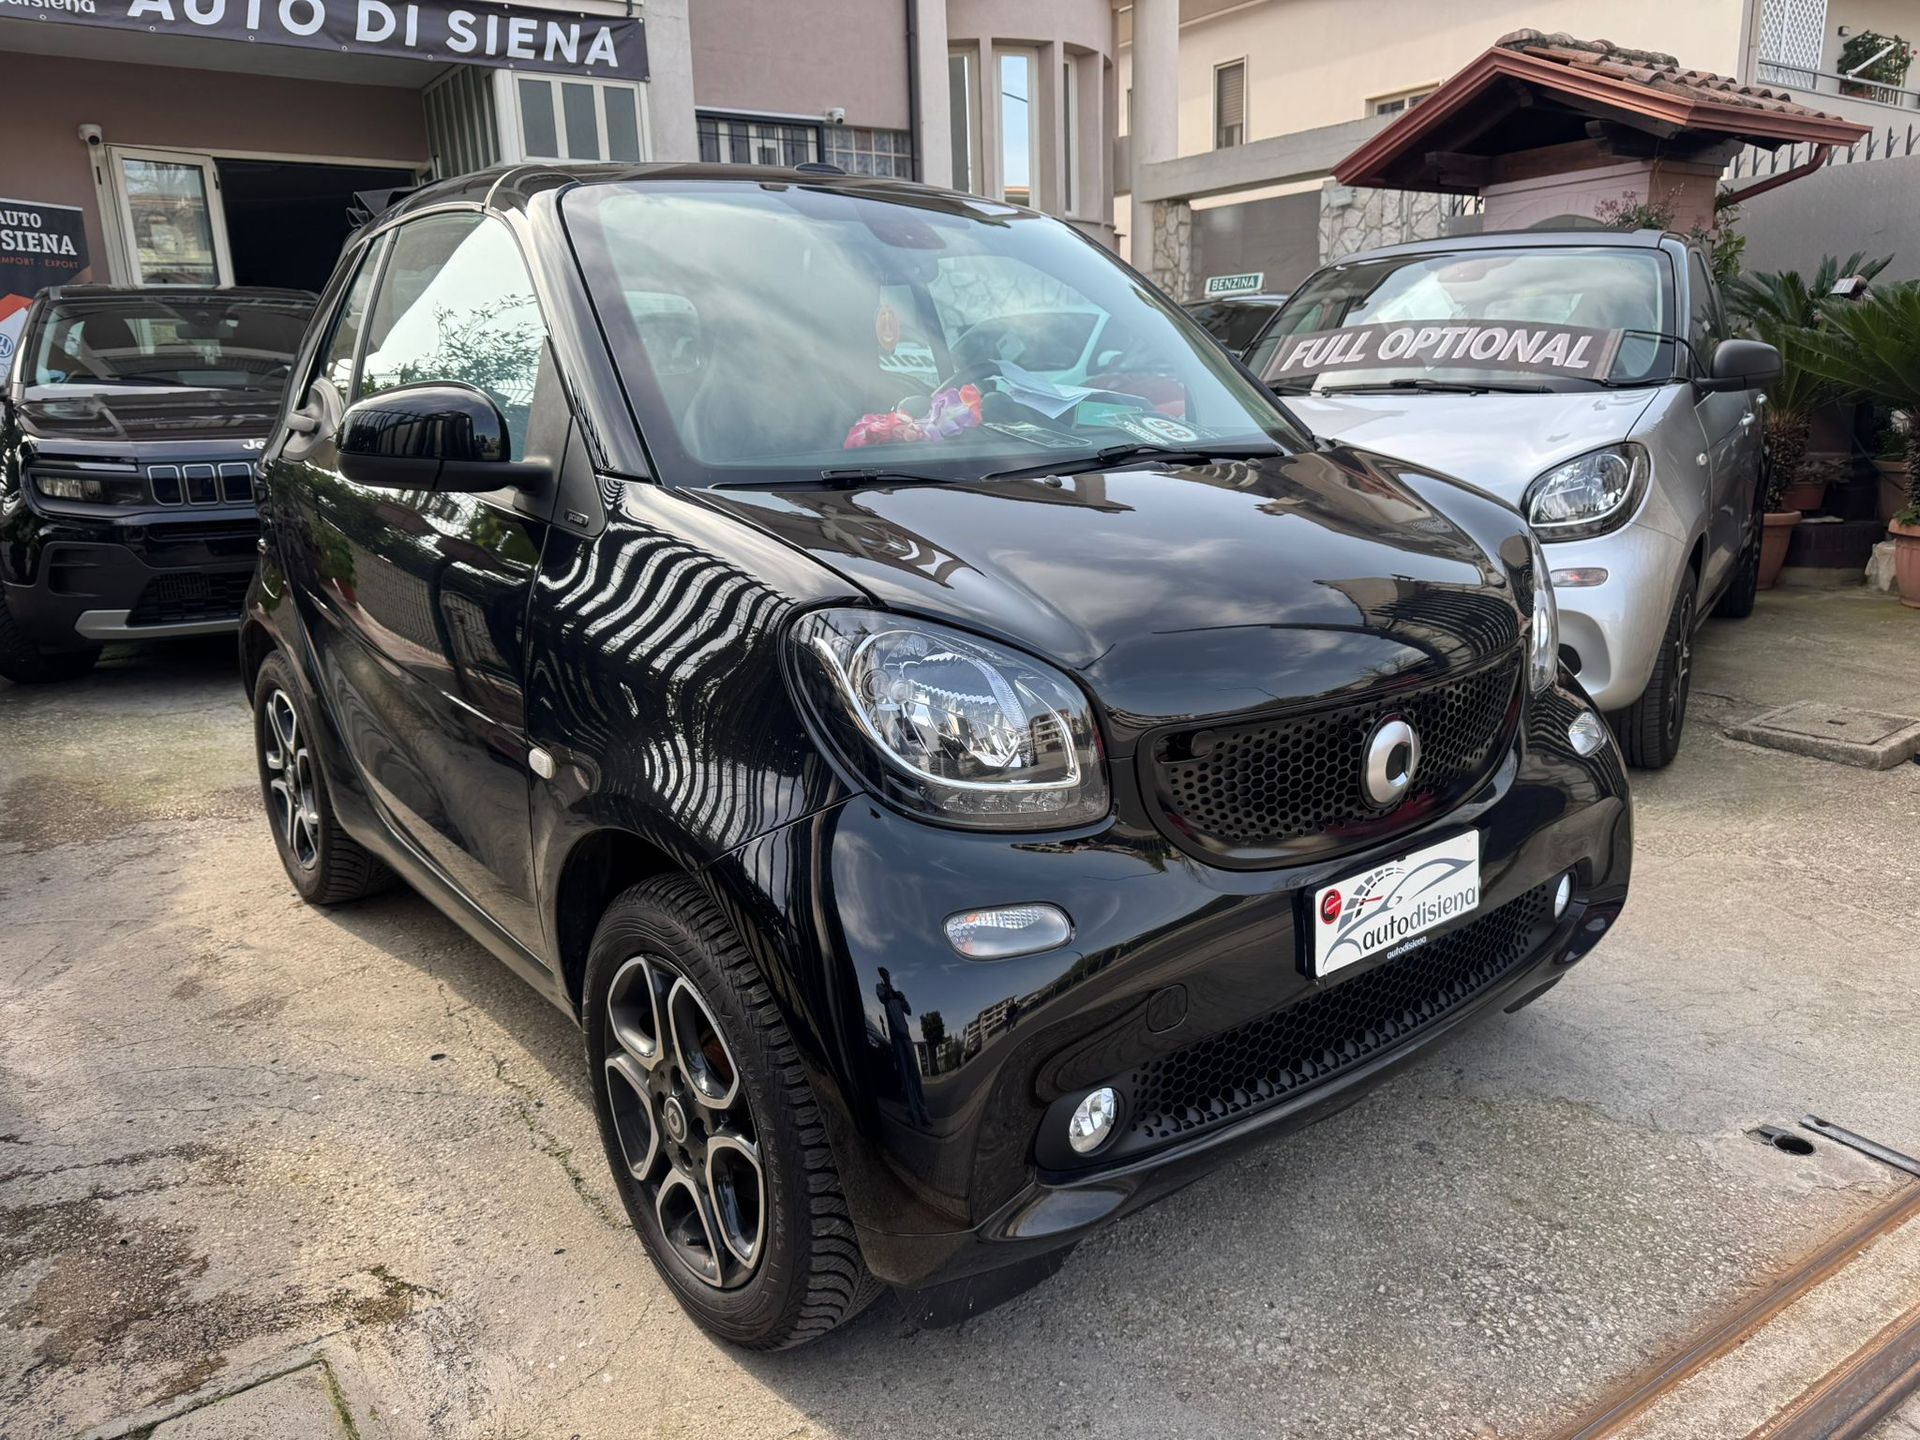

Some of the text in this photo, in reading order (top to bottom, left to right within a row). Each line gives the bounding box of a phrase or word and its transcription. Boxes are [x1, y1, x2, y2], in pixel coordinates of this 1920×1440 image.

[355, 0, 418, 47] DI
[445, 10, 619, 68] SIENA
[0, 229, 77, 256] SIENA
[0, 256, 34, 266] MPORT
[45, 259, 79, 269] EXPORT
[1211, 277, 1255, 291] BENZINA
[1280, 326, 1594, 372] FULL OPTIONAL
[242, 439, 266, 450] Je
[1363, 886, 1476, 950] autodisiena
